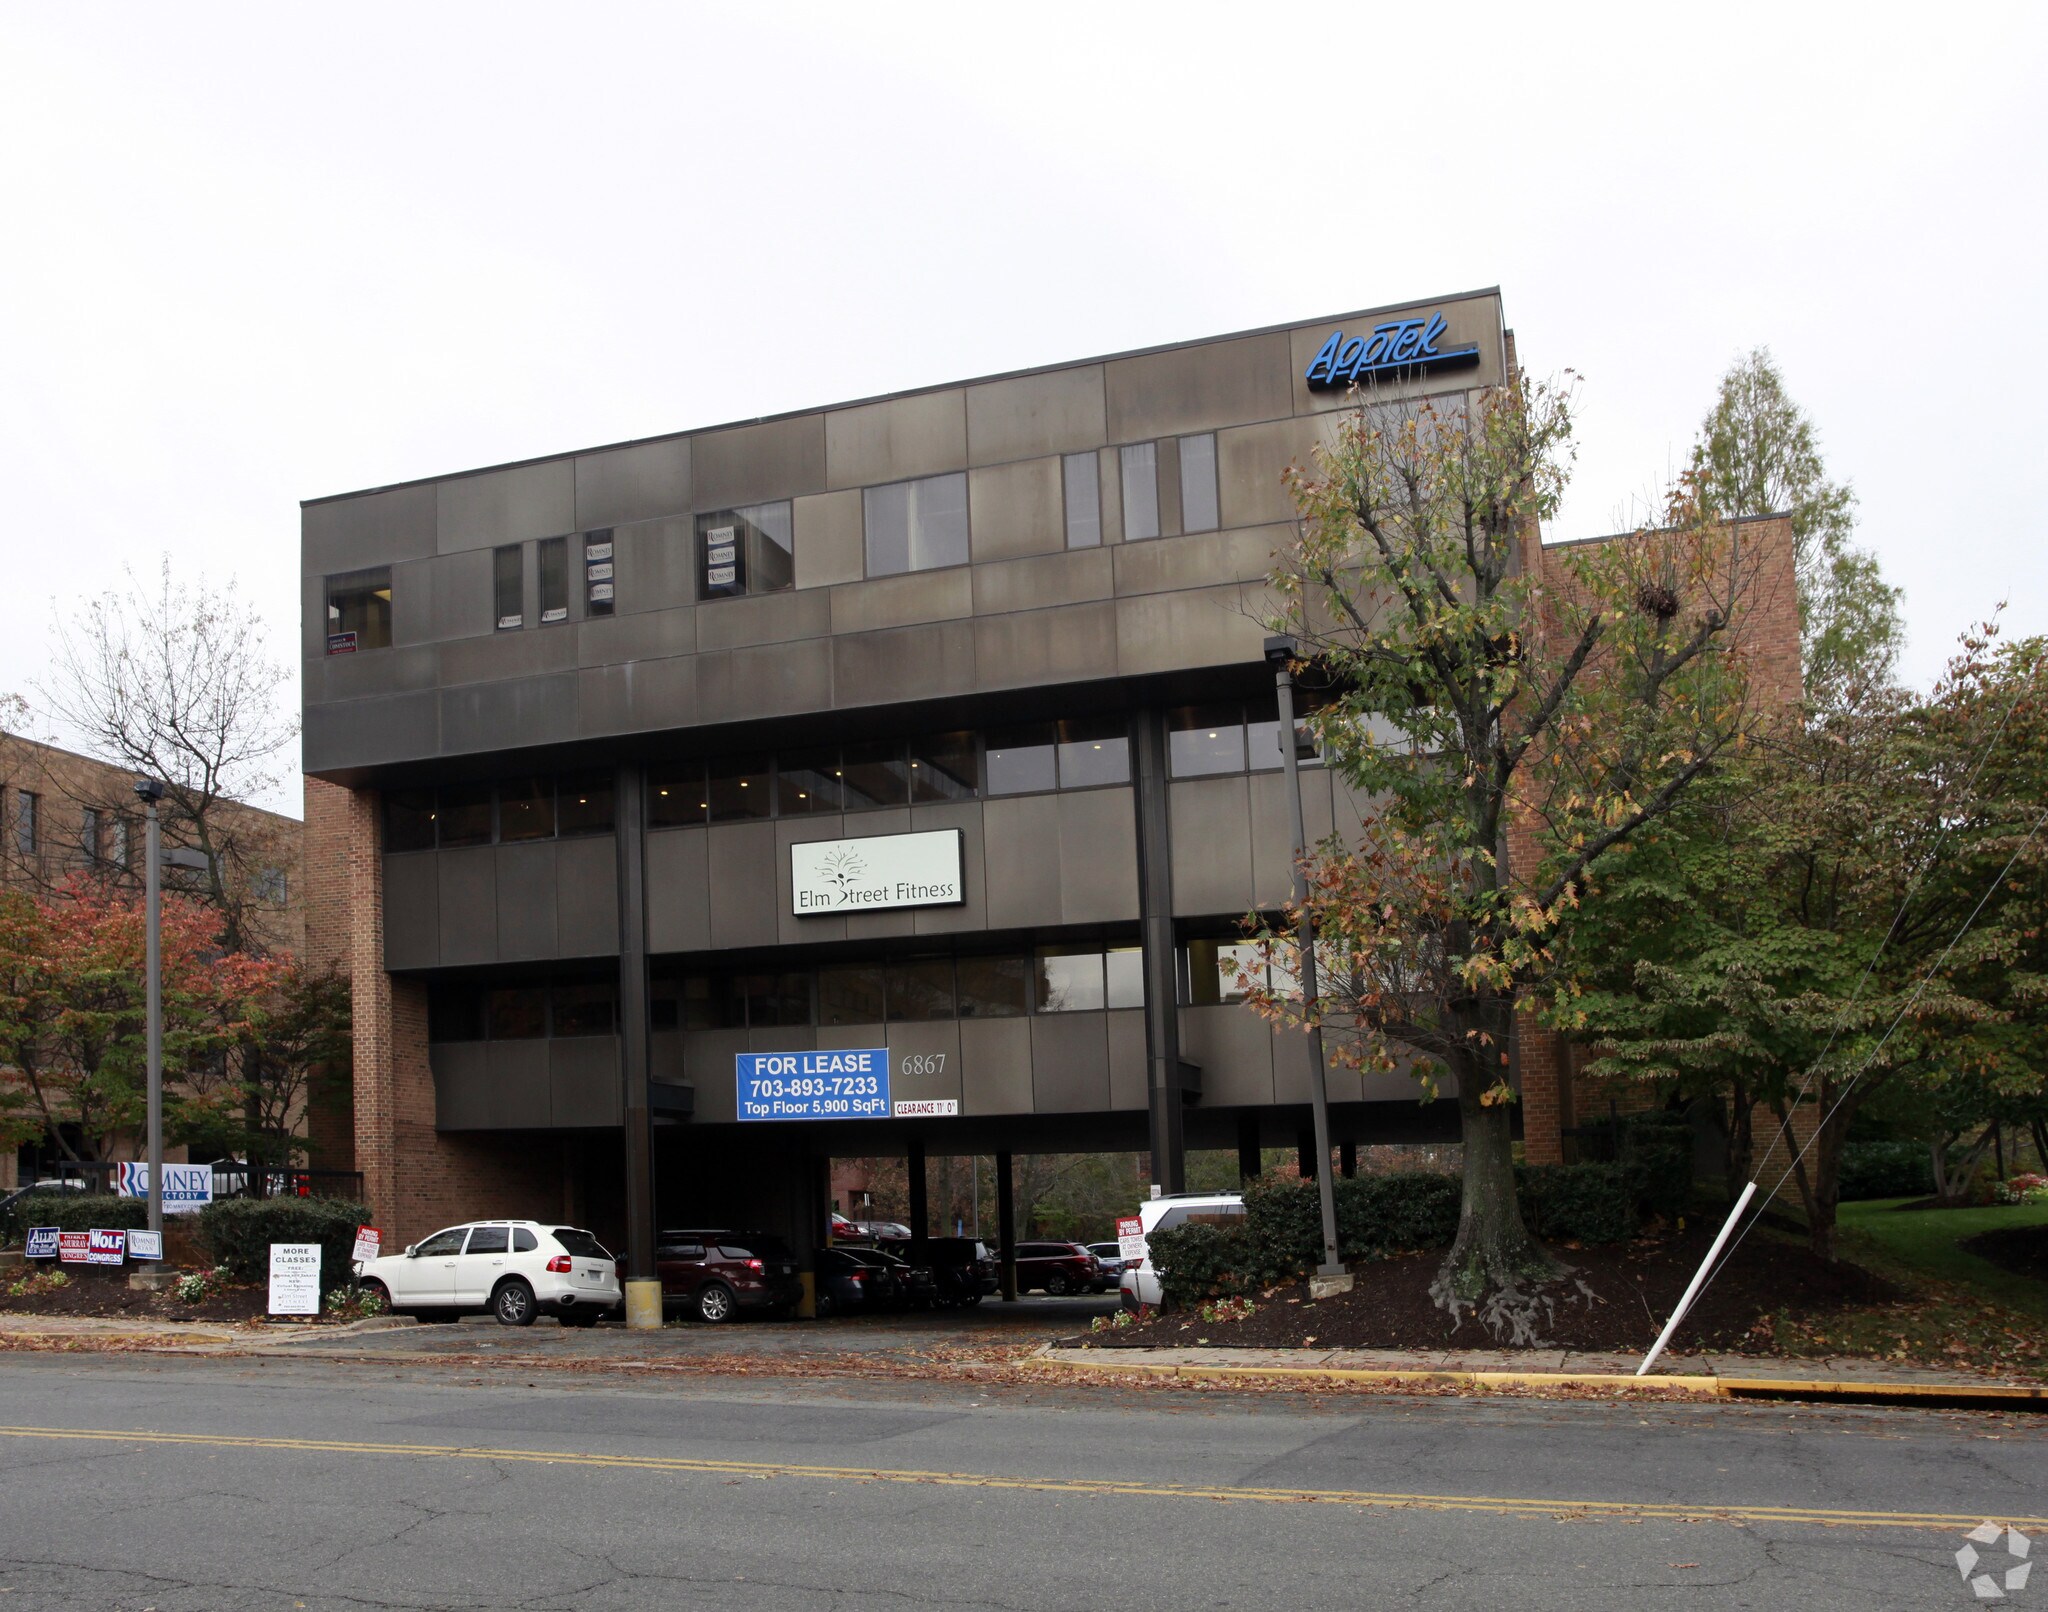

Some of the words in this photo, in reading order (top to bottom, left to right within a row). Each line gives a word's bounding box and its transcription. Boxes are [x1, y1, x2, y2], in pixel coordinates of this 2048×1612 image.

[800, 890, 831, 907] Elm
[896, 882, 954, 900] Fitness
[755, 1057, 797, 1075] FOR
[804, 1054, 871, 1074] LEASE
[902, 1054, 946, 1075] 6867
[750, 1076, 878, 1098] 703-893-7233
[745, 1102, 769, 1117] Top
[773, 1101, 808, 1114] Floor
[812, 1100, 848, 1114] 5,900
[853, 1098, 885, 1114] SqFt
[897, 1103, 934, 1114] CLEARANCE
[29, 1229, 58, 1243] ALLEN
[63, 1240, 86, 1248] MURRAY
[91, 1231, 123, 1249] WOLF
[89, 1252, 121, 1263] CONGRESS
